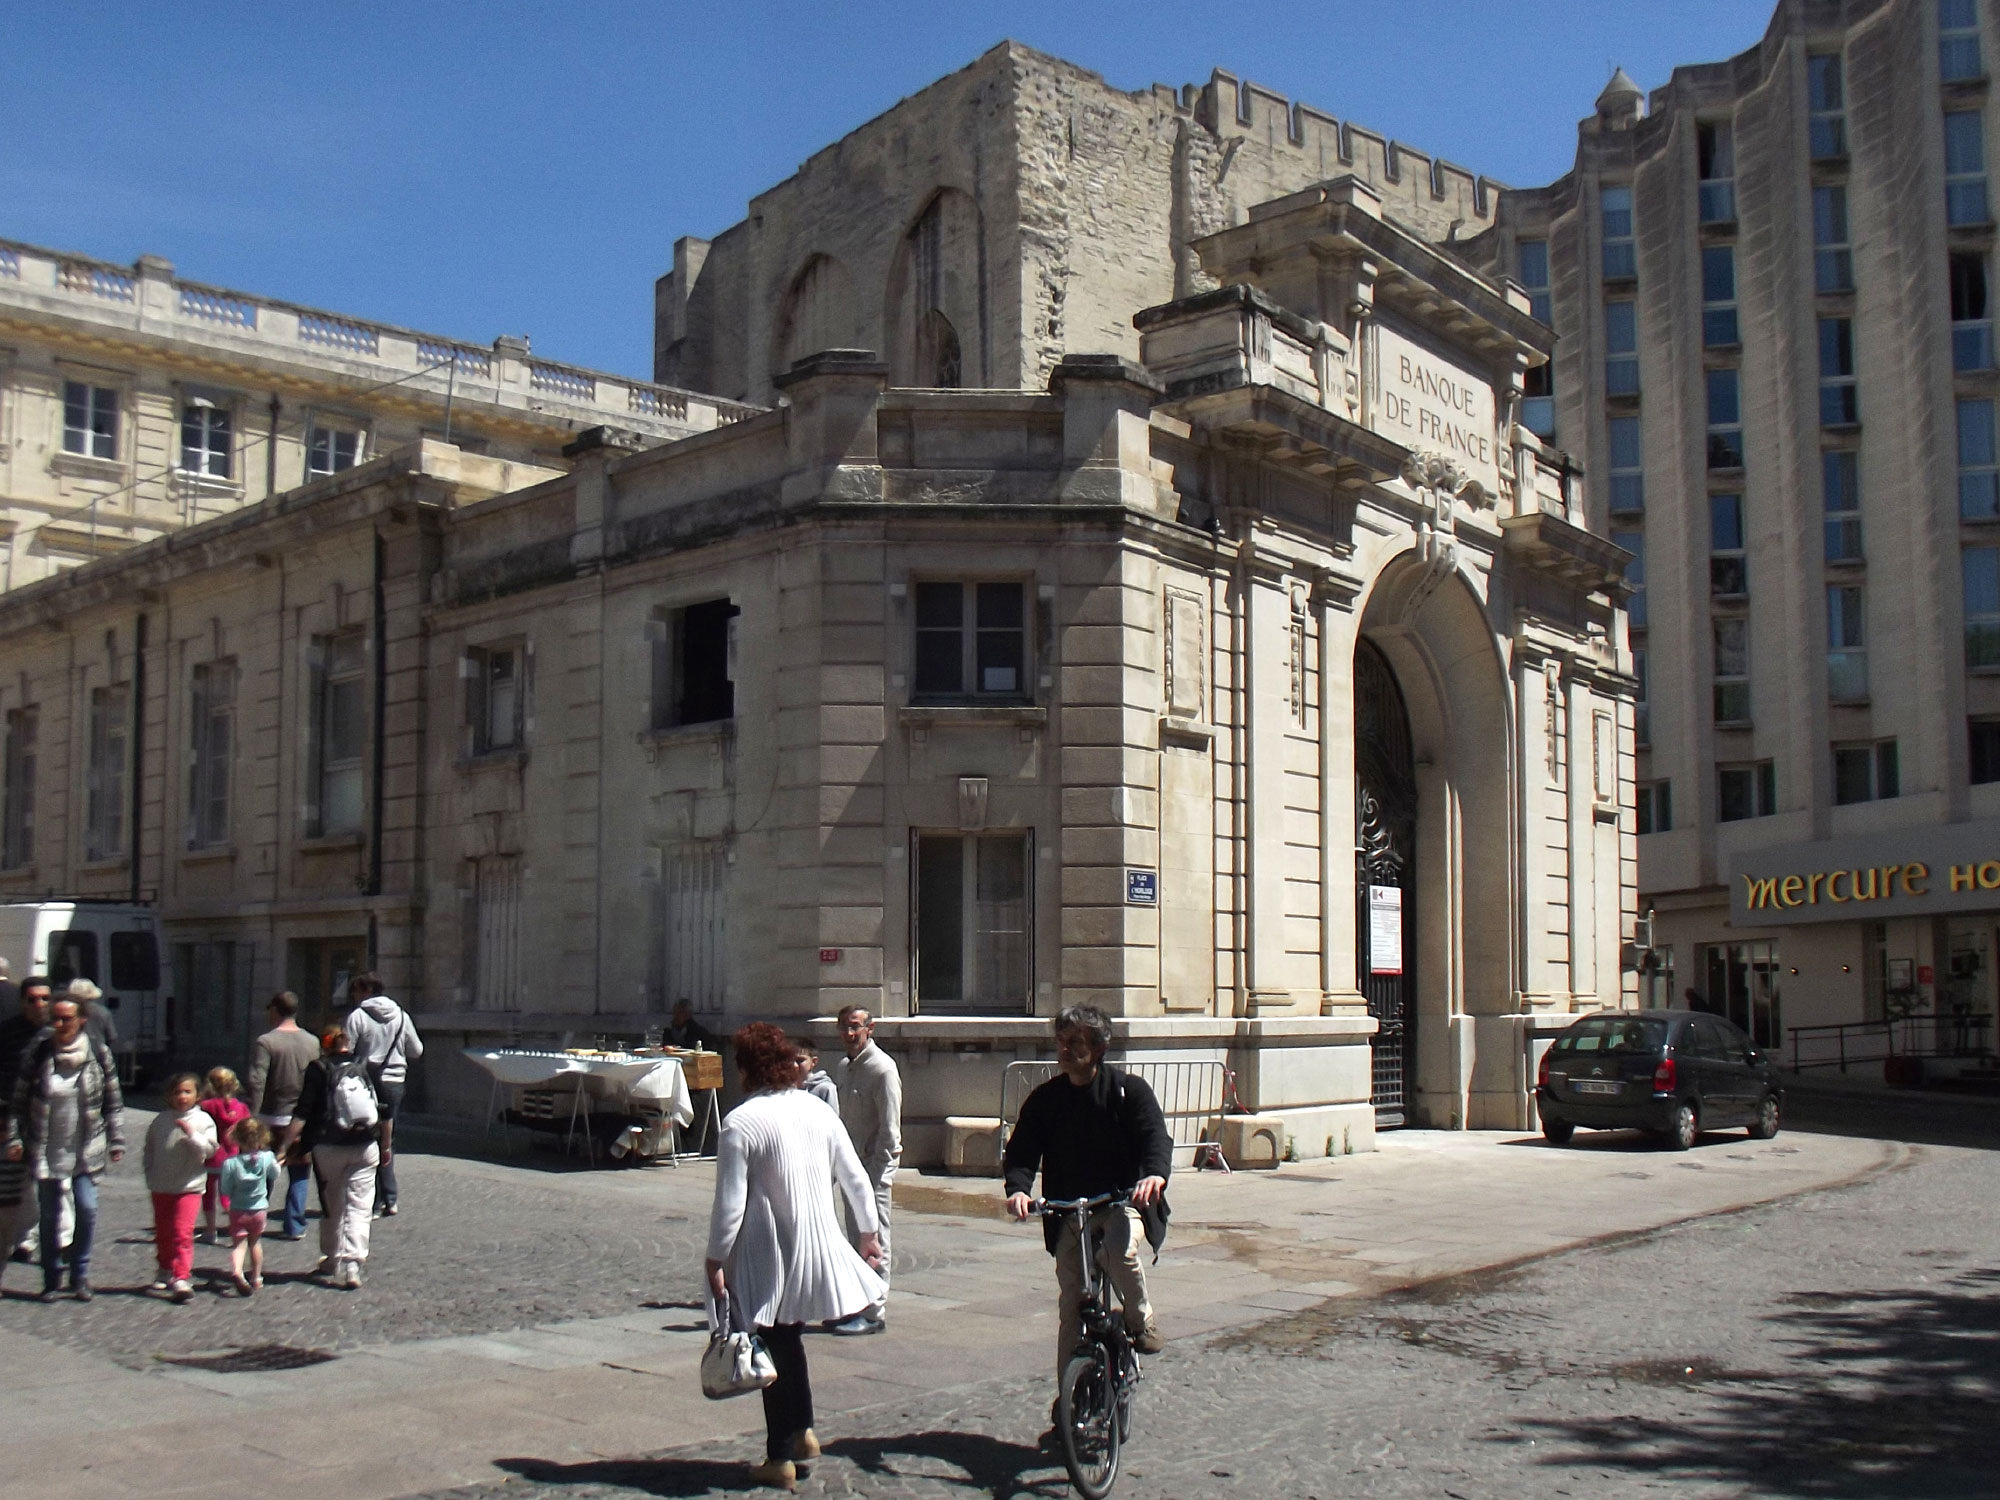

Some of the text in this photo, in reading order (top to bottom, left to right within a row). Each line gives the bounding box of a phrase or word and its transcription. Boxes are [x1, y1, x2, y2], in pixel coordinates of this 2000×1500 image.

[1399, 354, 1476, 418] BANQUE
[1385, 390, 1490, 465] DE FRANCE
